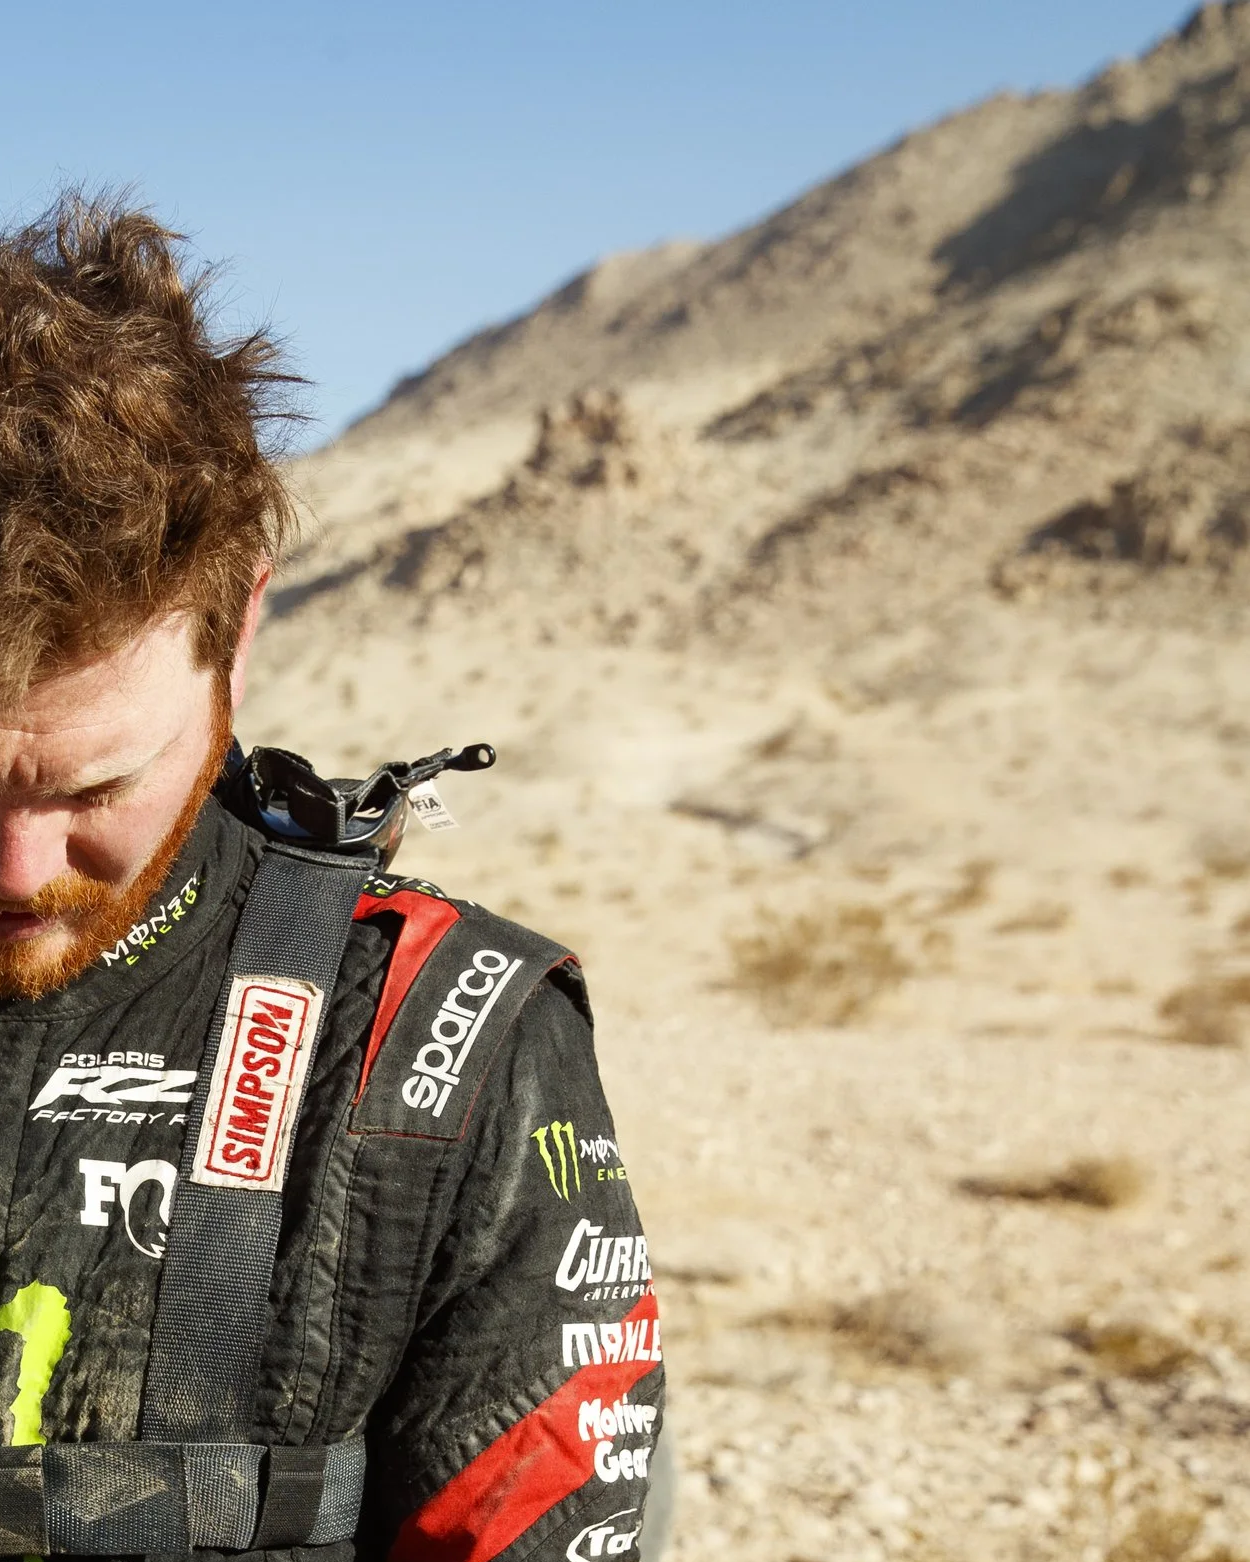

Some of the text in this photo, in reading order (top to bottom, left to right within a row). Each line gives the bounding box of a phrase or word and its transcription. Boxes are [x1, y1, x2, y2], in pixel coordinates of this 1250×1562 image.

[402, 949, 523, 1118] sparco
[60, 1051, 165, 1068] POLARIS
[221, 999, 295, 1171] SIMPSON
[32, 1108, 165, 1126] FACTORY
[597, 1167, 627, 1181] ENE
[79, 1158, 178, 1259] FO
[555, 1218, 653, 1291] CURR
[578, 1393, 658, 1442] Motive
[594, 1440, 651, 1484] Gear
